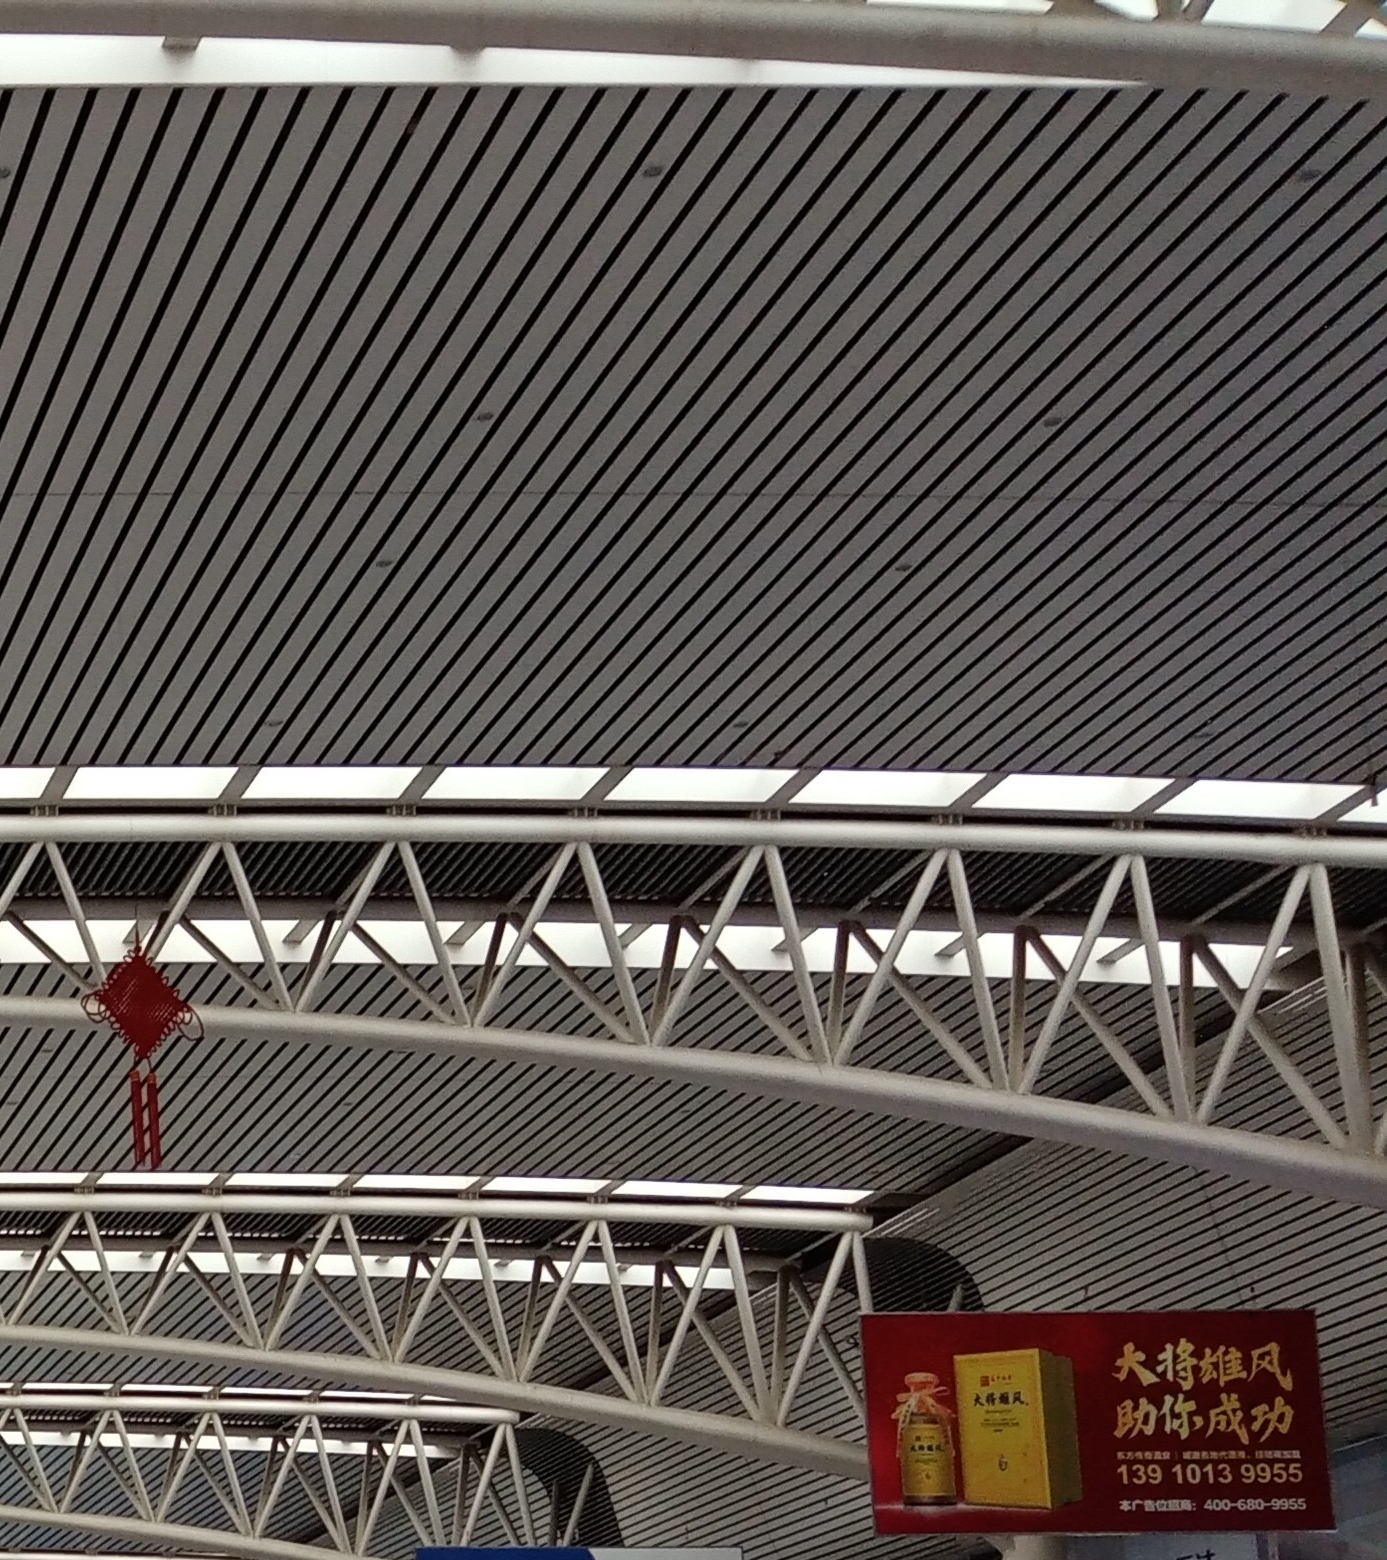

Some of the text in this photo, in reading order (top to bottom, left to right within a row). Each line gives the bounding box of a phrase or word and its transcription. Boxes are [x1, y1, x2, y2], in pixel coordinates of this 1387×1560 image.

[1111, 1337, 1294, 1391] 大将雄风
[1113, 1392, 1295, 1445] 助你成功
[1116, 1462, 1304, 1485] 139 1013 9955
[1203, 1498, 1307, 1512] 400-680-9955
